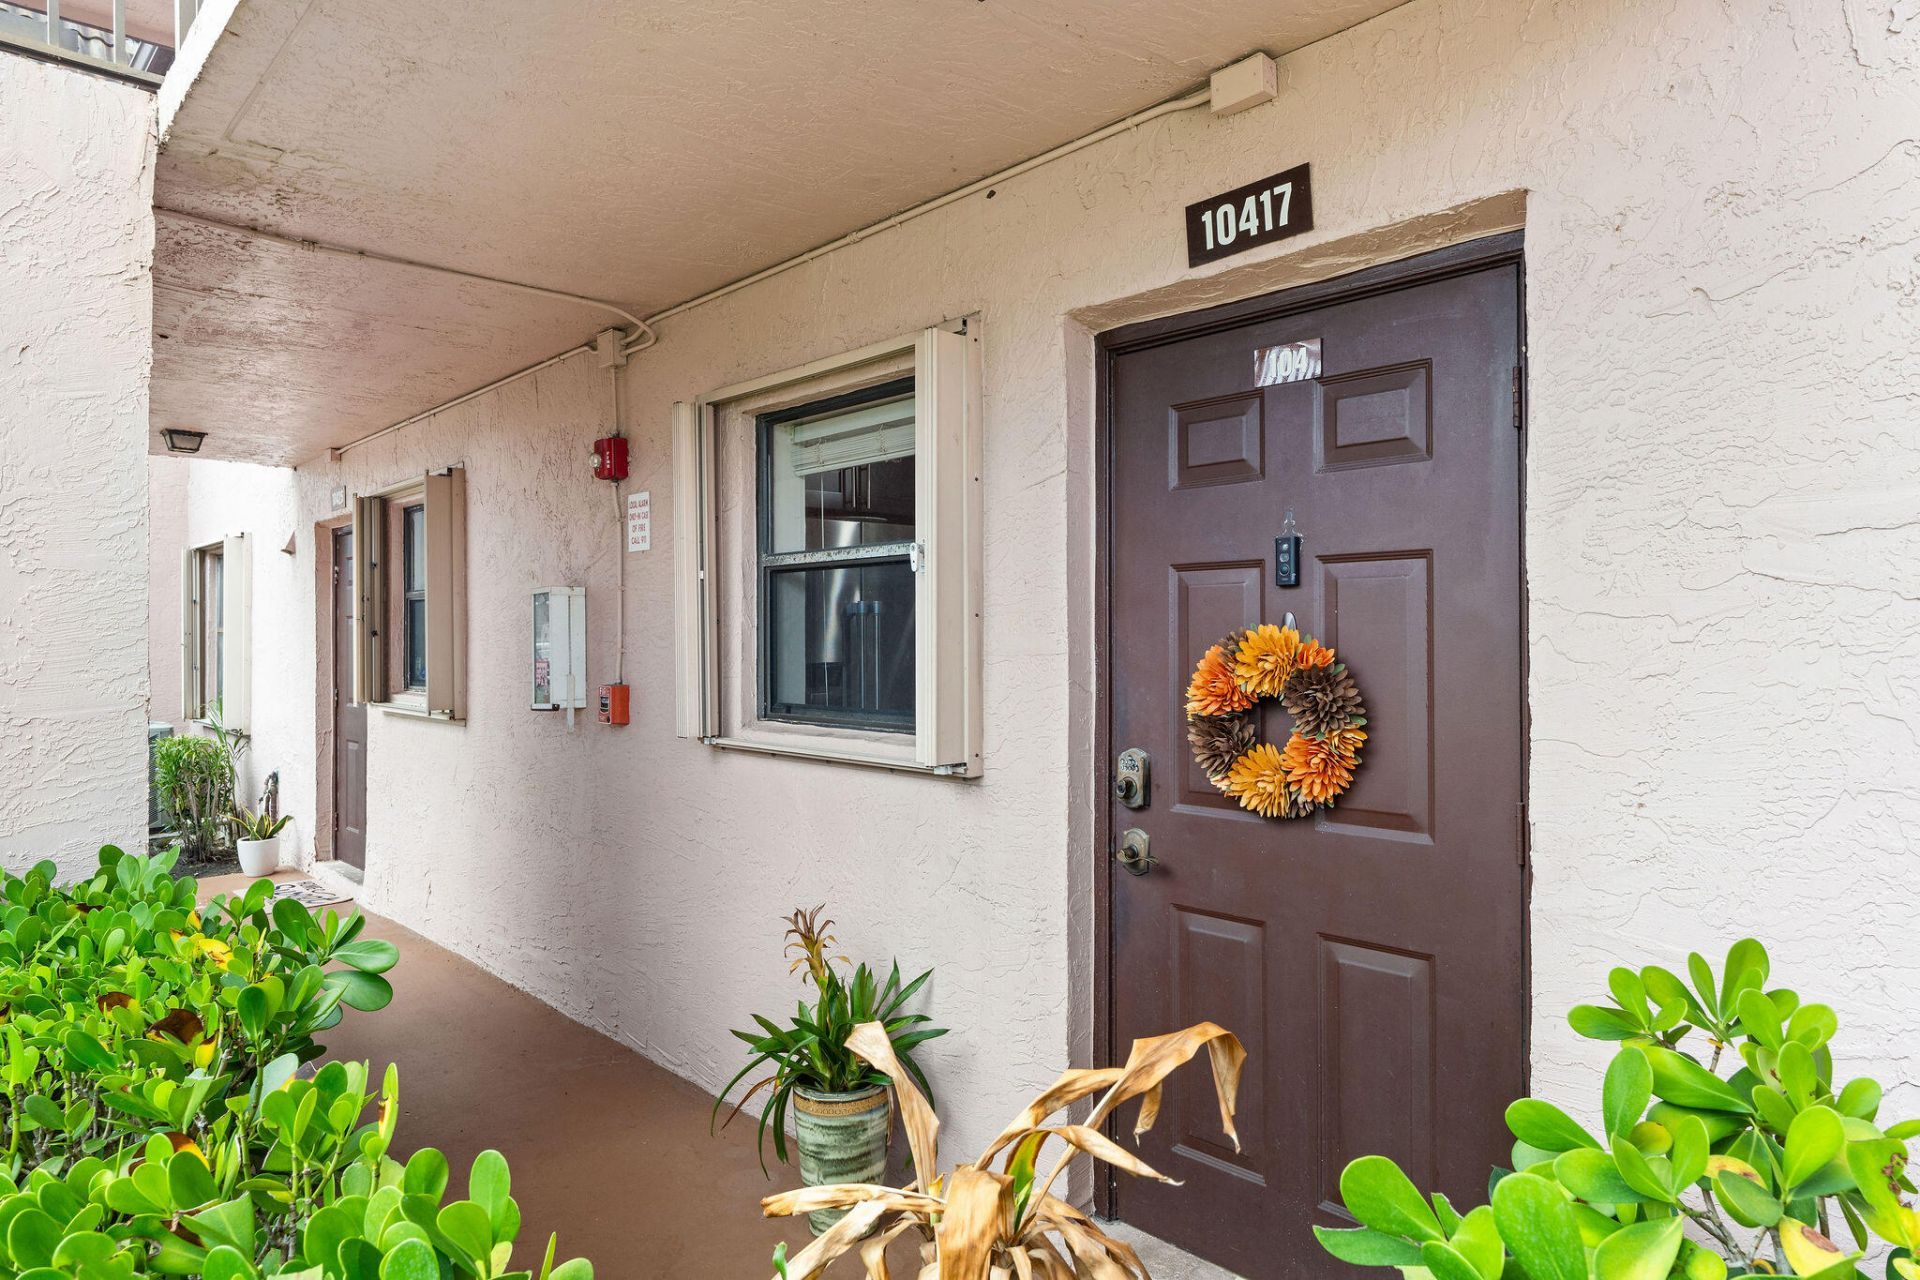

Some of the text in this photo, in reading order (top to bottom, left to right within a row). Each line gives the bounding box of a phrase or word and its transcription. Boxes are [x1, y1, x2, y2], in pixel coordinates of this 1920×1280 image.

[1201, 181, 1293, 250] 10417
[632, 523, 646, 533] OF FIRE
[632, 537, 640, 545] CALL
